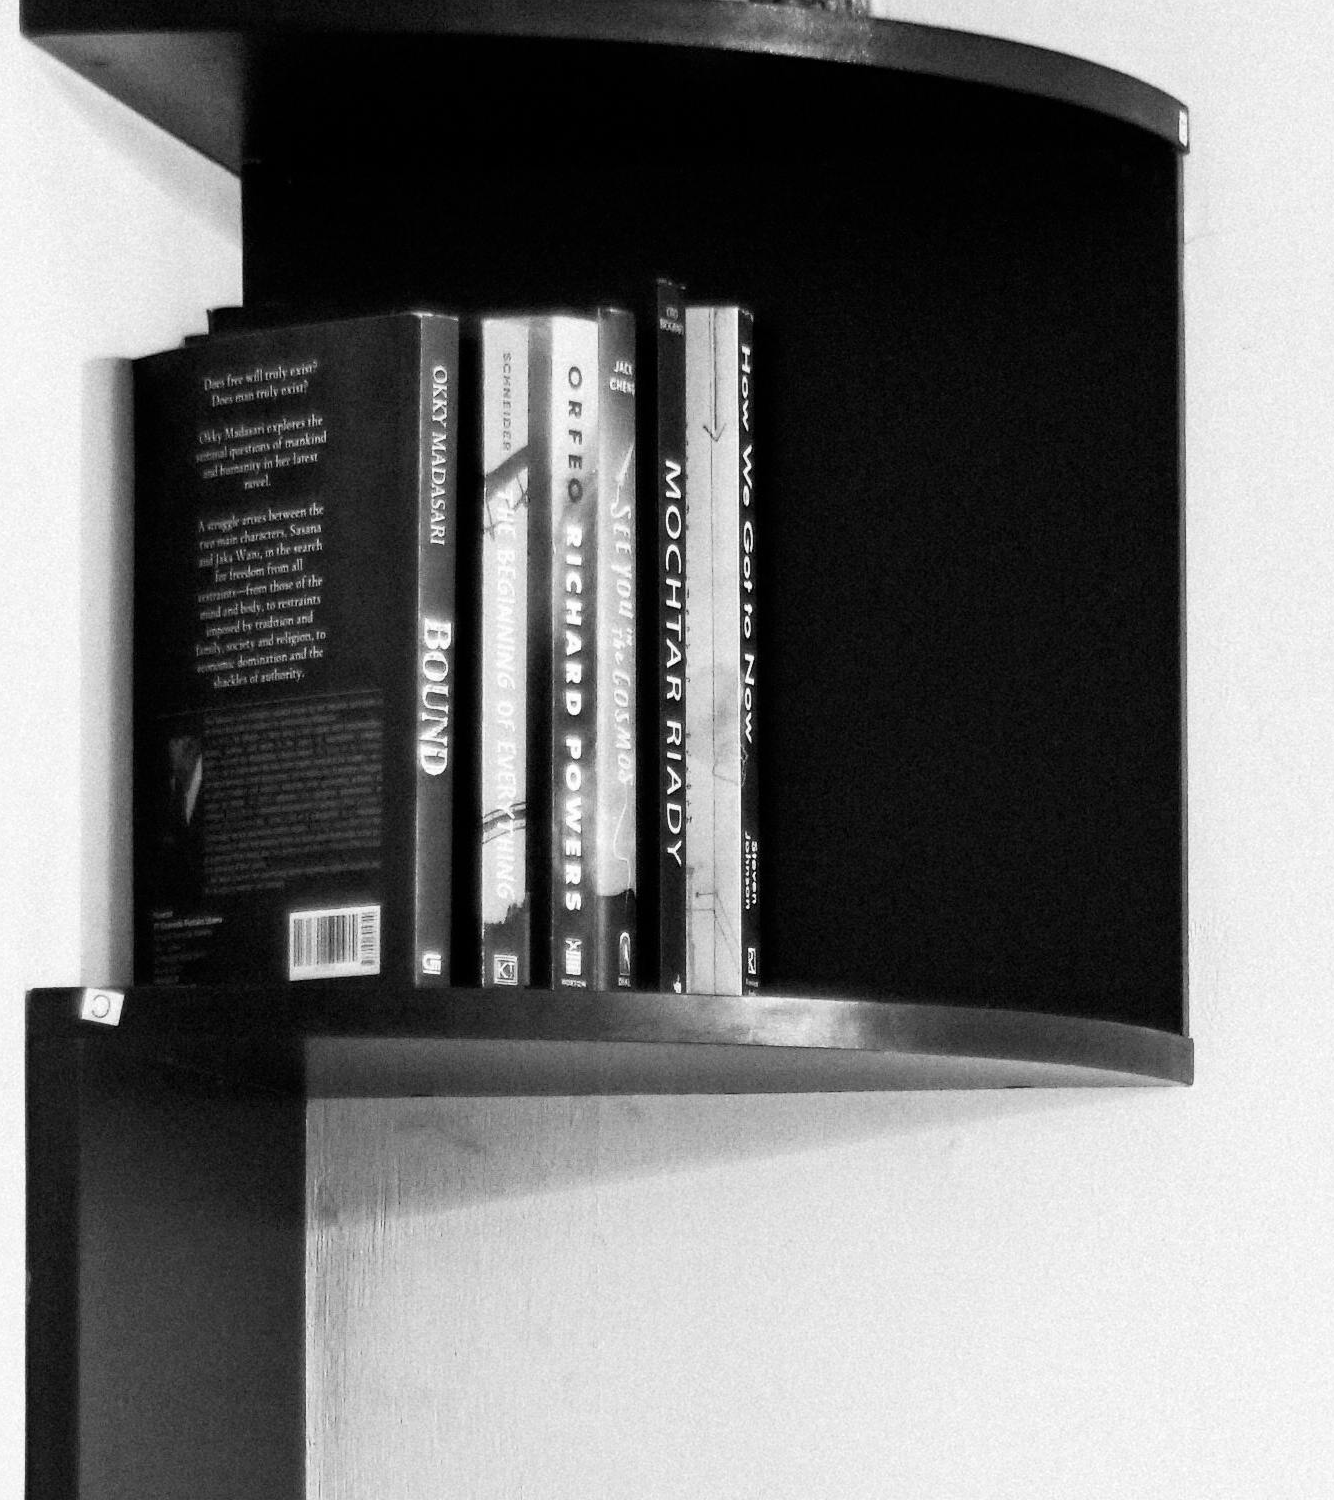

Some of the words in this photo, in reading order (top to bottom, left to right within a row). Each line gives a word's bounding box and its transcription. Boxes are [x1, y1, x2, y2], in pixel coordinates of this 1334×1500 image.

[227, 373, 243, 387] free
[245, 369, 263, 384] will
[265, 366, 285, 383] truly
[289, 361, 317, 378] exist?
[255, 385, 277, 402] truly
[281, 380, 308, 396] exist?
[741, 345, 751, 432] How
[432, 365, 447, 428] OKKY
[502, 352, 512, 451] SCHNEIDER
[265, 418, 305, 436] explores
[307, 414, 323, 428] the
[271, 436, 283, 450] of
[285, 430, 327, 448] mankind
[568, 366, 583, 503] ORFEO
[263, 458, 273, 469] in
[275, 454, 289, 468] her
[293, 449, 317, 465] latest
[742, 444, 752, 507] We
[244, 474, 271, 490] novel.
[430, 431, 447, 546] MADASARI
[267, 507, 307, 522] between
[307, 503, 323, 517] the
[265, 546, 273, 558] in
[275, 542, 291, 556] the
[293, 537, 323, 554] search
[743, 520, 753, 593] Got
[229, 564, 265, 580] freedom
[267, 562, 289, 575] from
[291, 557, 303, 572] all
[269, 579, 293, 593] those
[295, 575, 307, 589] of
[307, 574, 323, 588] the
[665, 458, 682, 701] MOCHTAR
[265, 598, 275, 611] to
[277, 592, 321, 609] restraints
[295, 610, 313, 625] and
[497, 549, 516, 690] BEGINNING
[566, 525, 582, 716] RICHARD
[743, 603, 753, 639] to
[257, 633, 273, 647] and
[315, 627, 326, 640] to
[289, 646, 307, 661] and
[309, 645, 323, 658] the
[419, 617, 452, 776] BOUND
[743, 653, 755, 744] Now
[497, 701, 515, 733] OF
[666, 720, 682, 867] RIADY
[566, 736, 582, 911] POWERS
